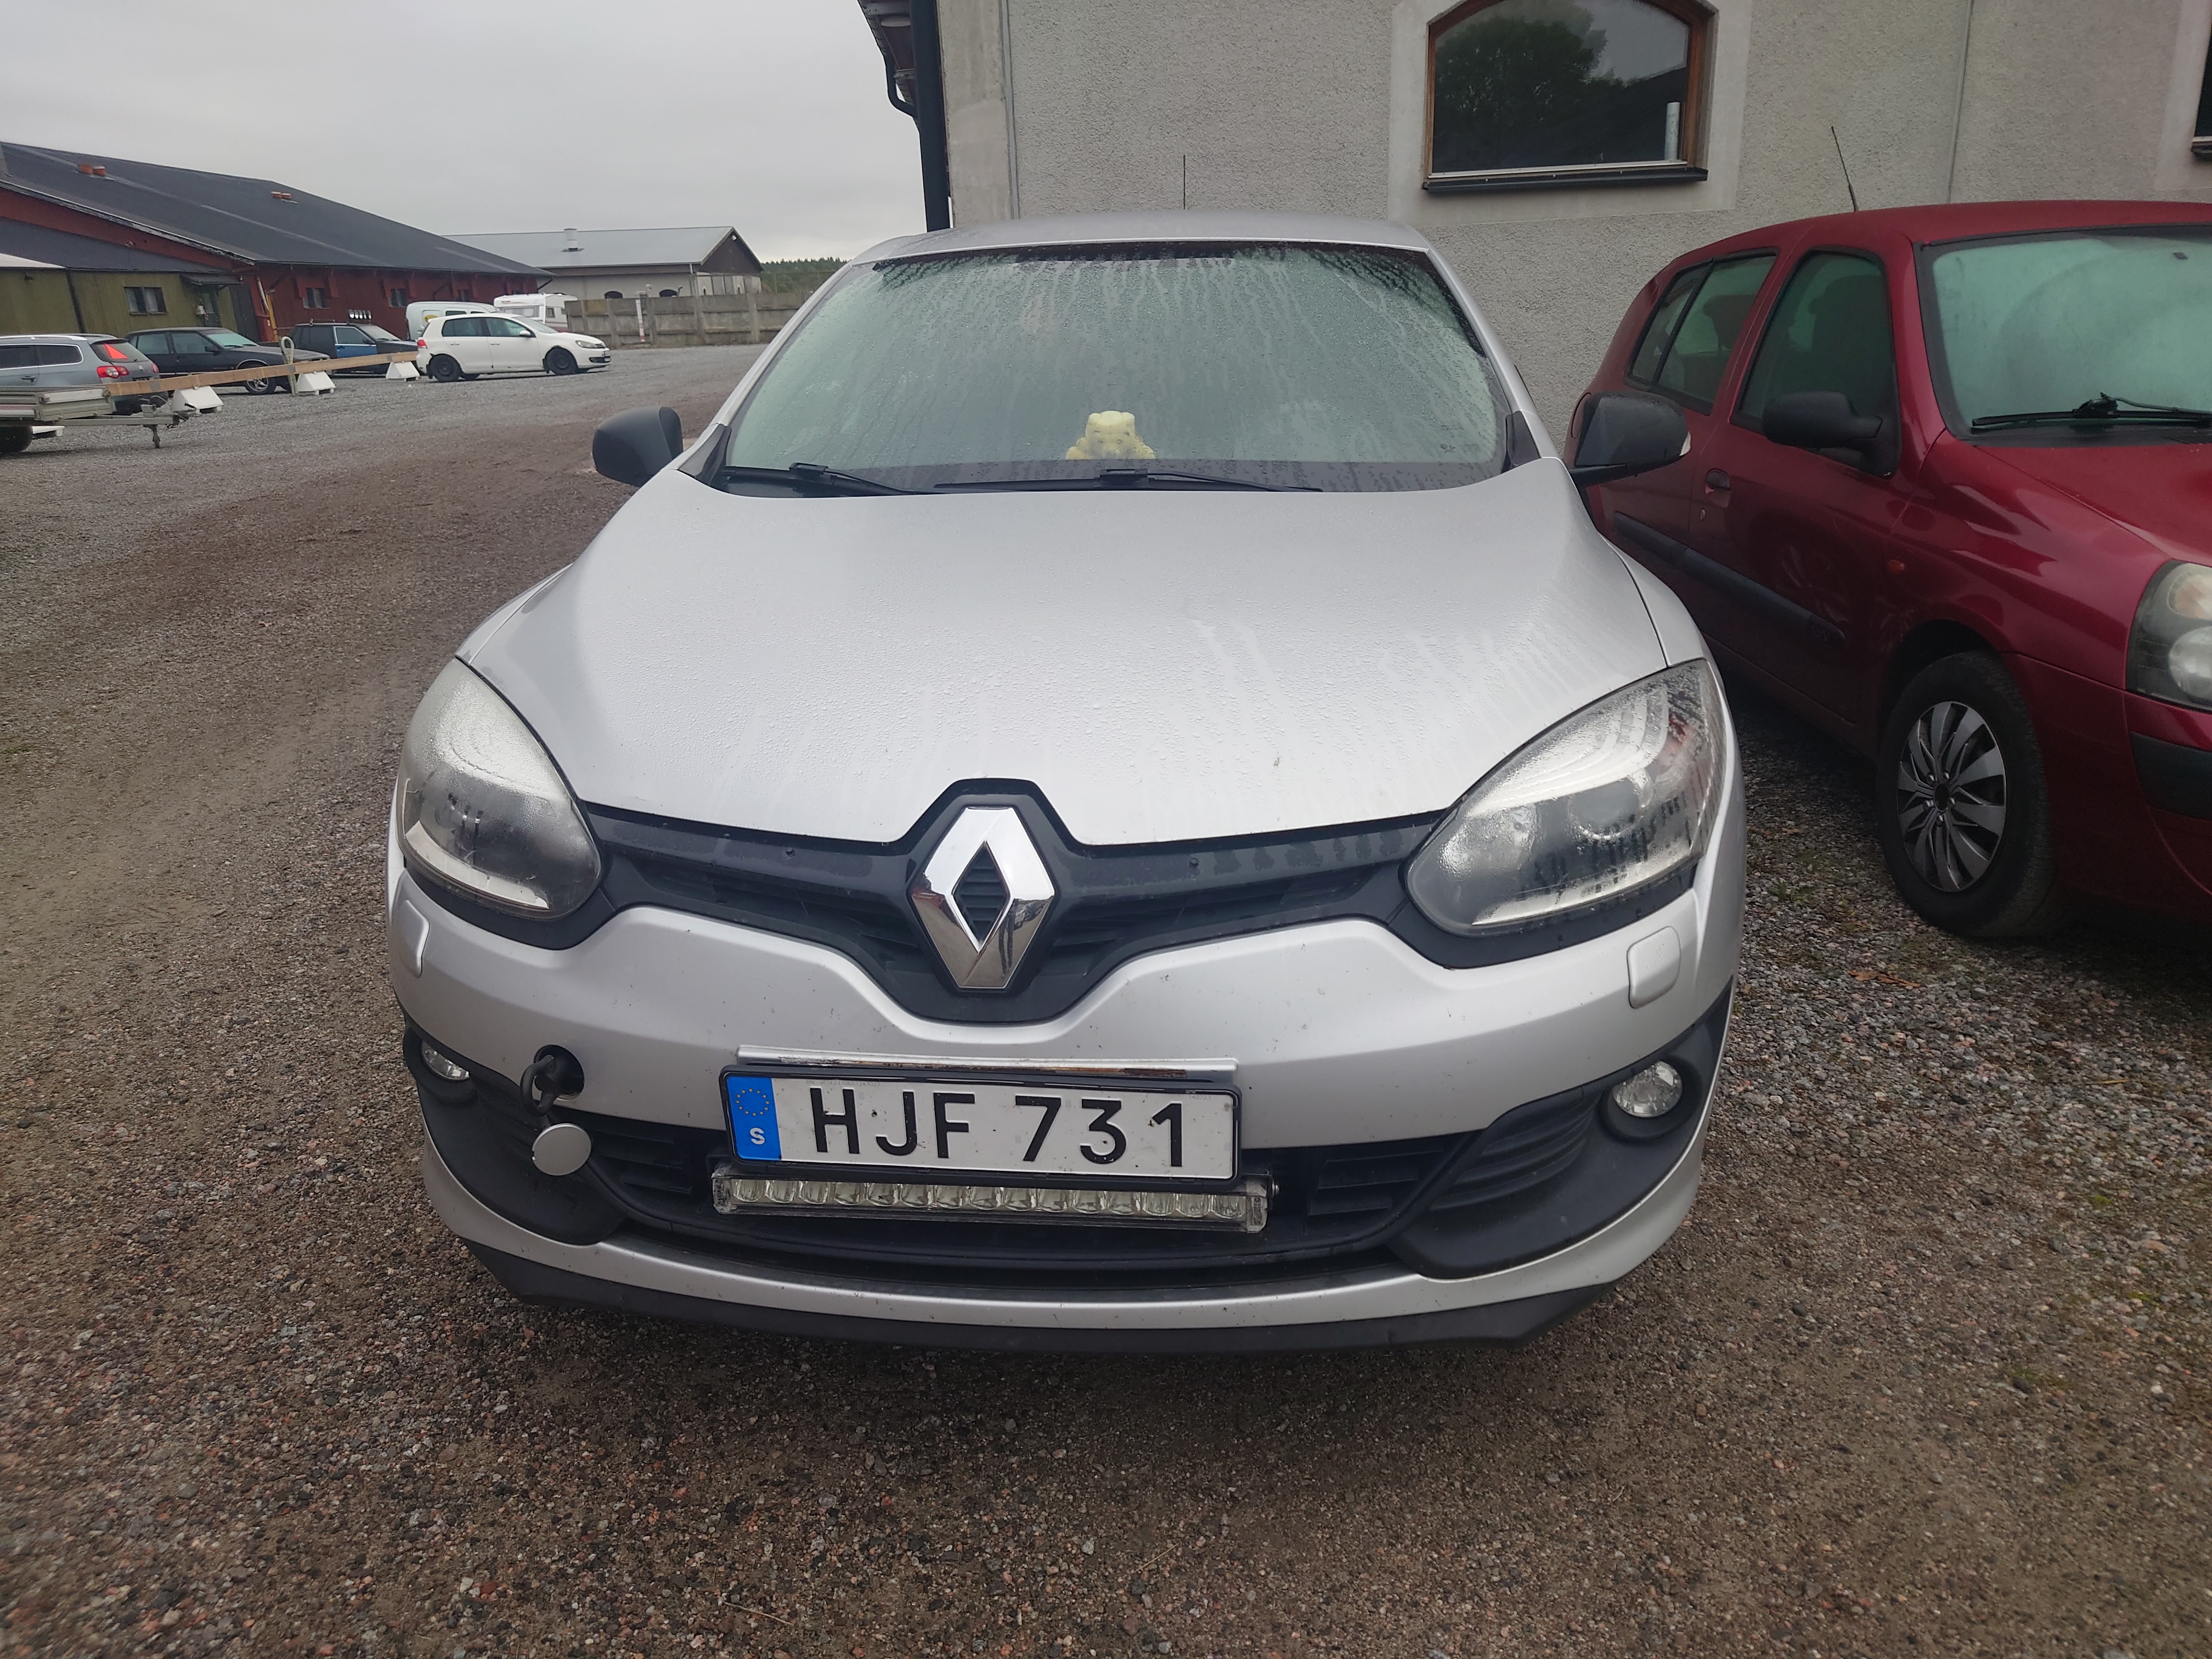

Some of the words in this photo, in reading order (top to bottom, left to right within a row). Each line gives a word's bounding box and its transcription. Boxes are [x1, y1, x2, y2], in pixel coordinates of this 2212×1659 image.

[749, 1127, 765, 1145] S
[810, 1087, 975, 1159] HJF
[1015, 1095, 1182, 1167] 731
